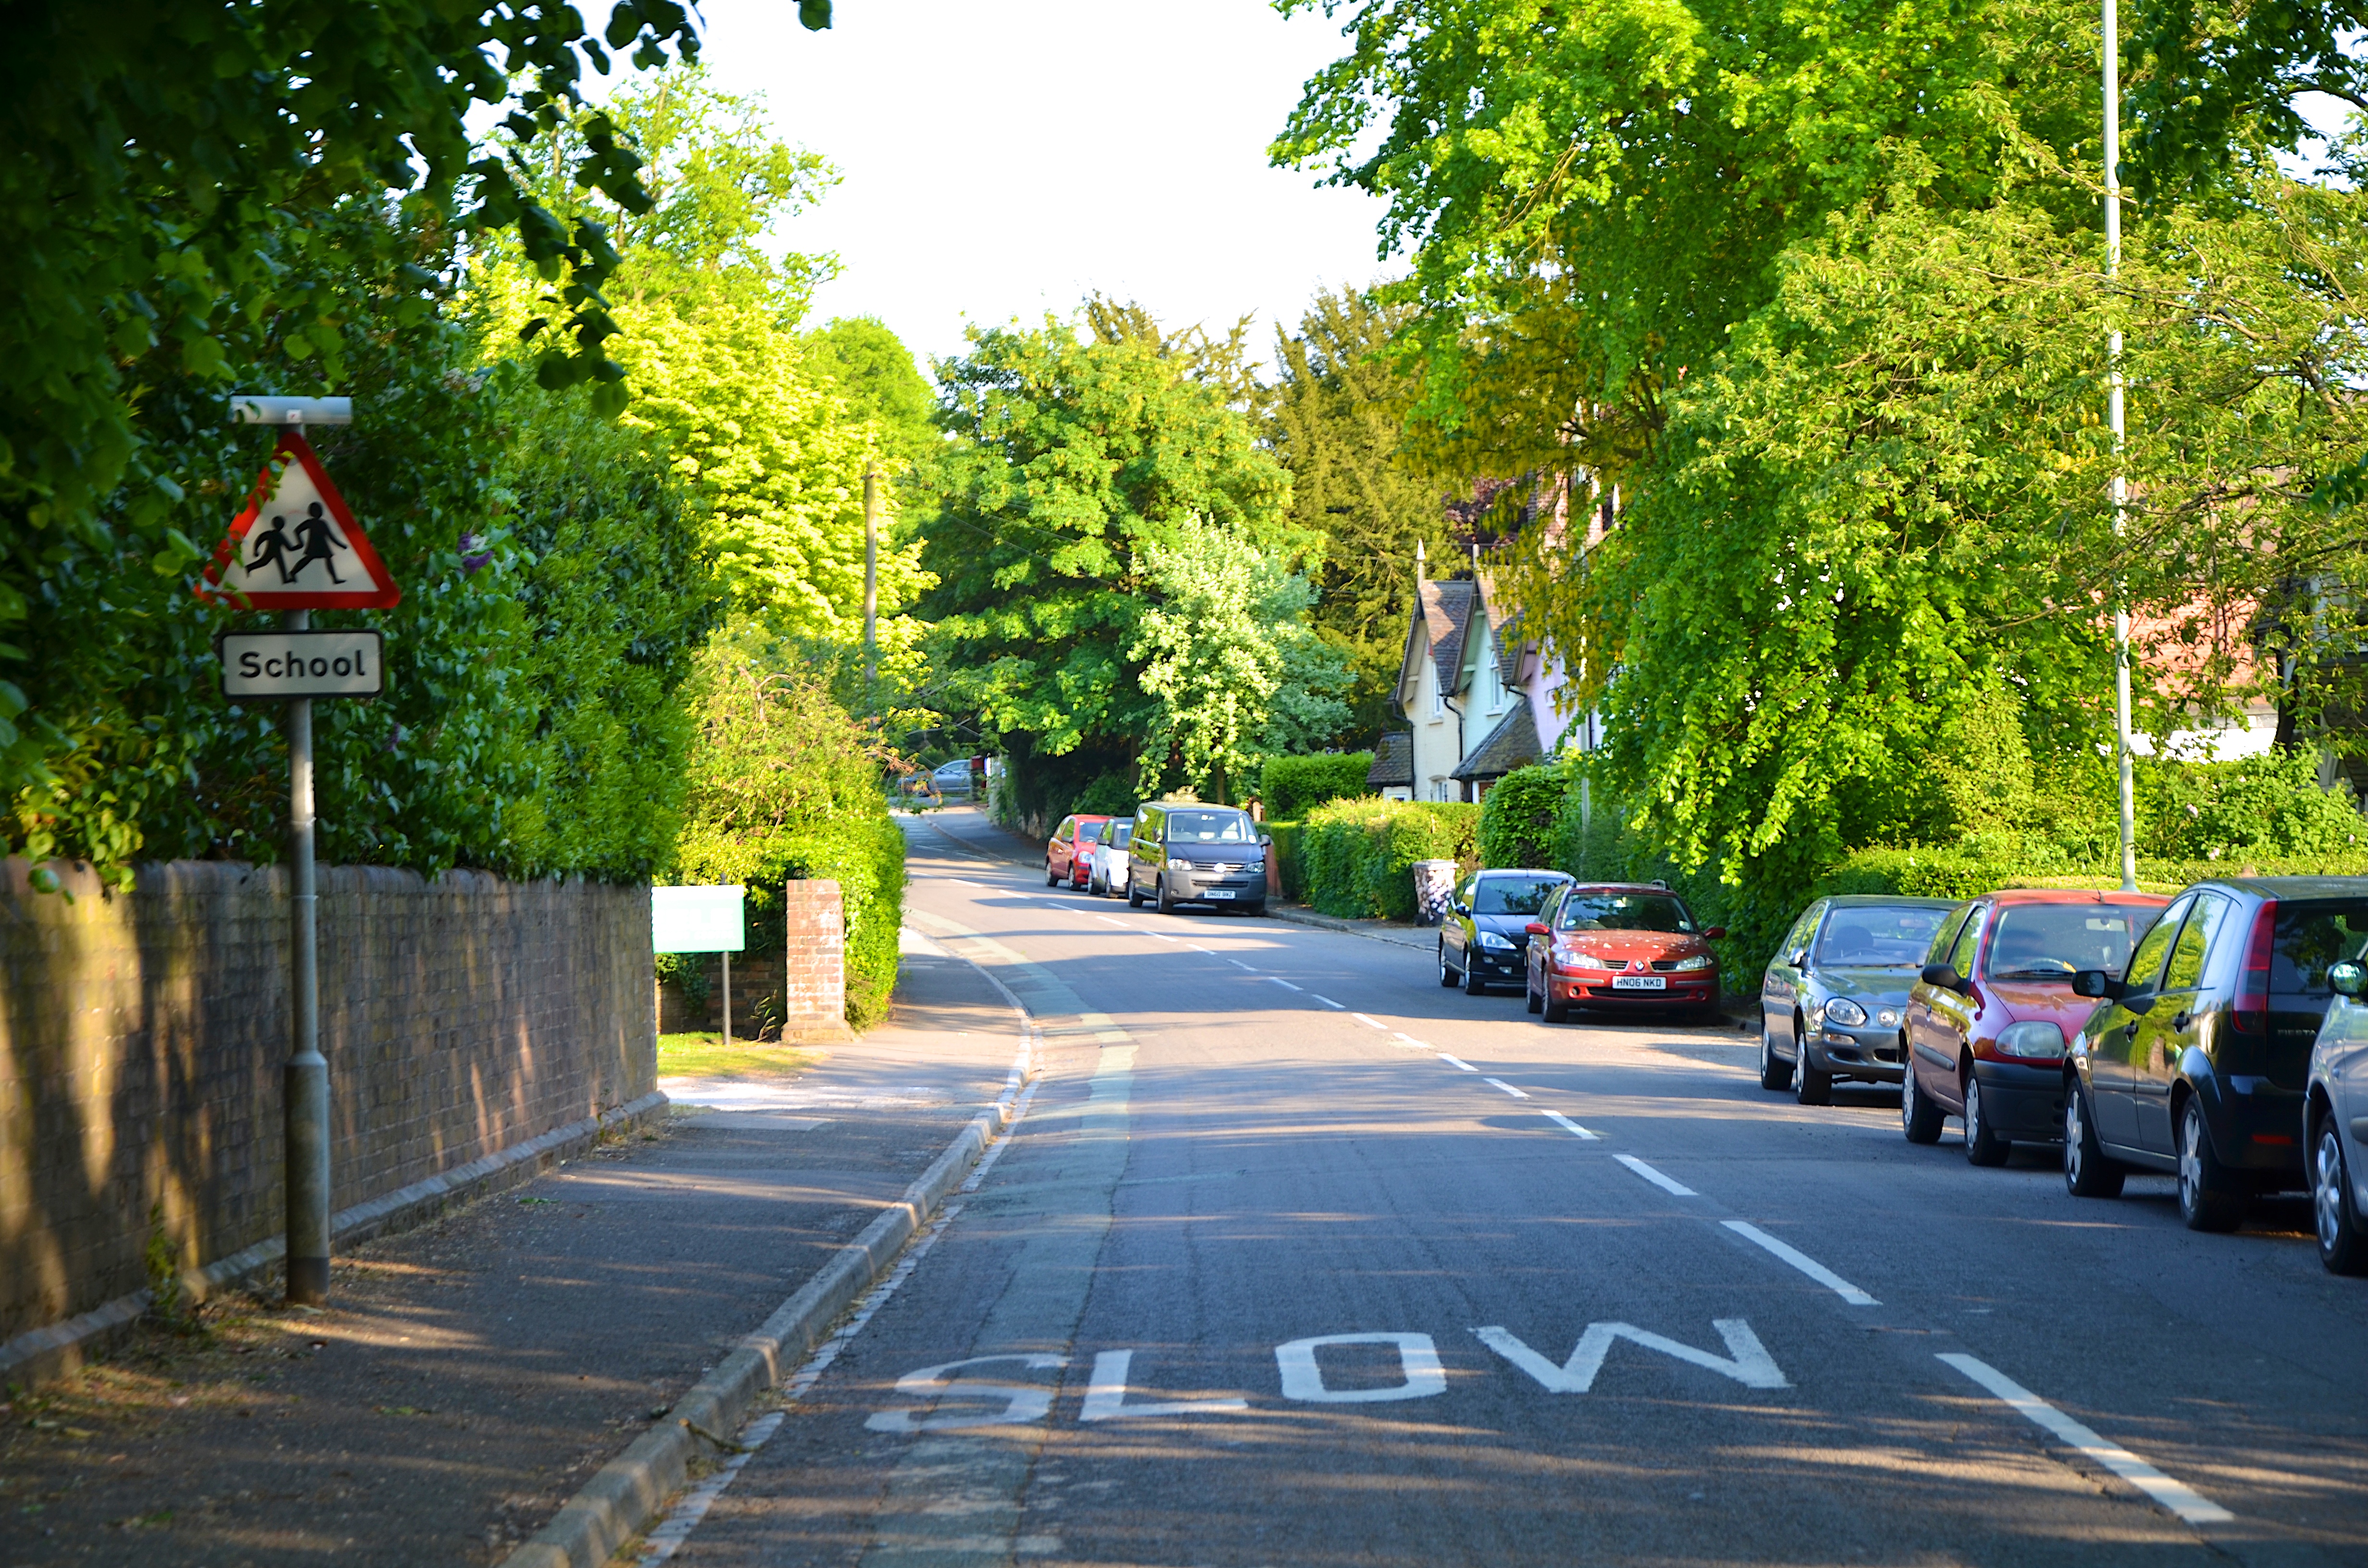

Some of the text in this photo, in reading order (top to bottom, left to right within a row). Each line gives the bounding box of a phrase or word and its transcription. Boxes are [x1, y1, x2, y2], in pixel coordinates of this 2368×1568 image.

[239, 649, 366, 678] School
[1616, 978, 1661, 987] HN06 NKD
[864, 1318, 1796, 1433] SLOW
